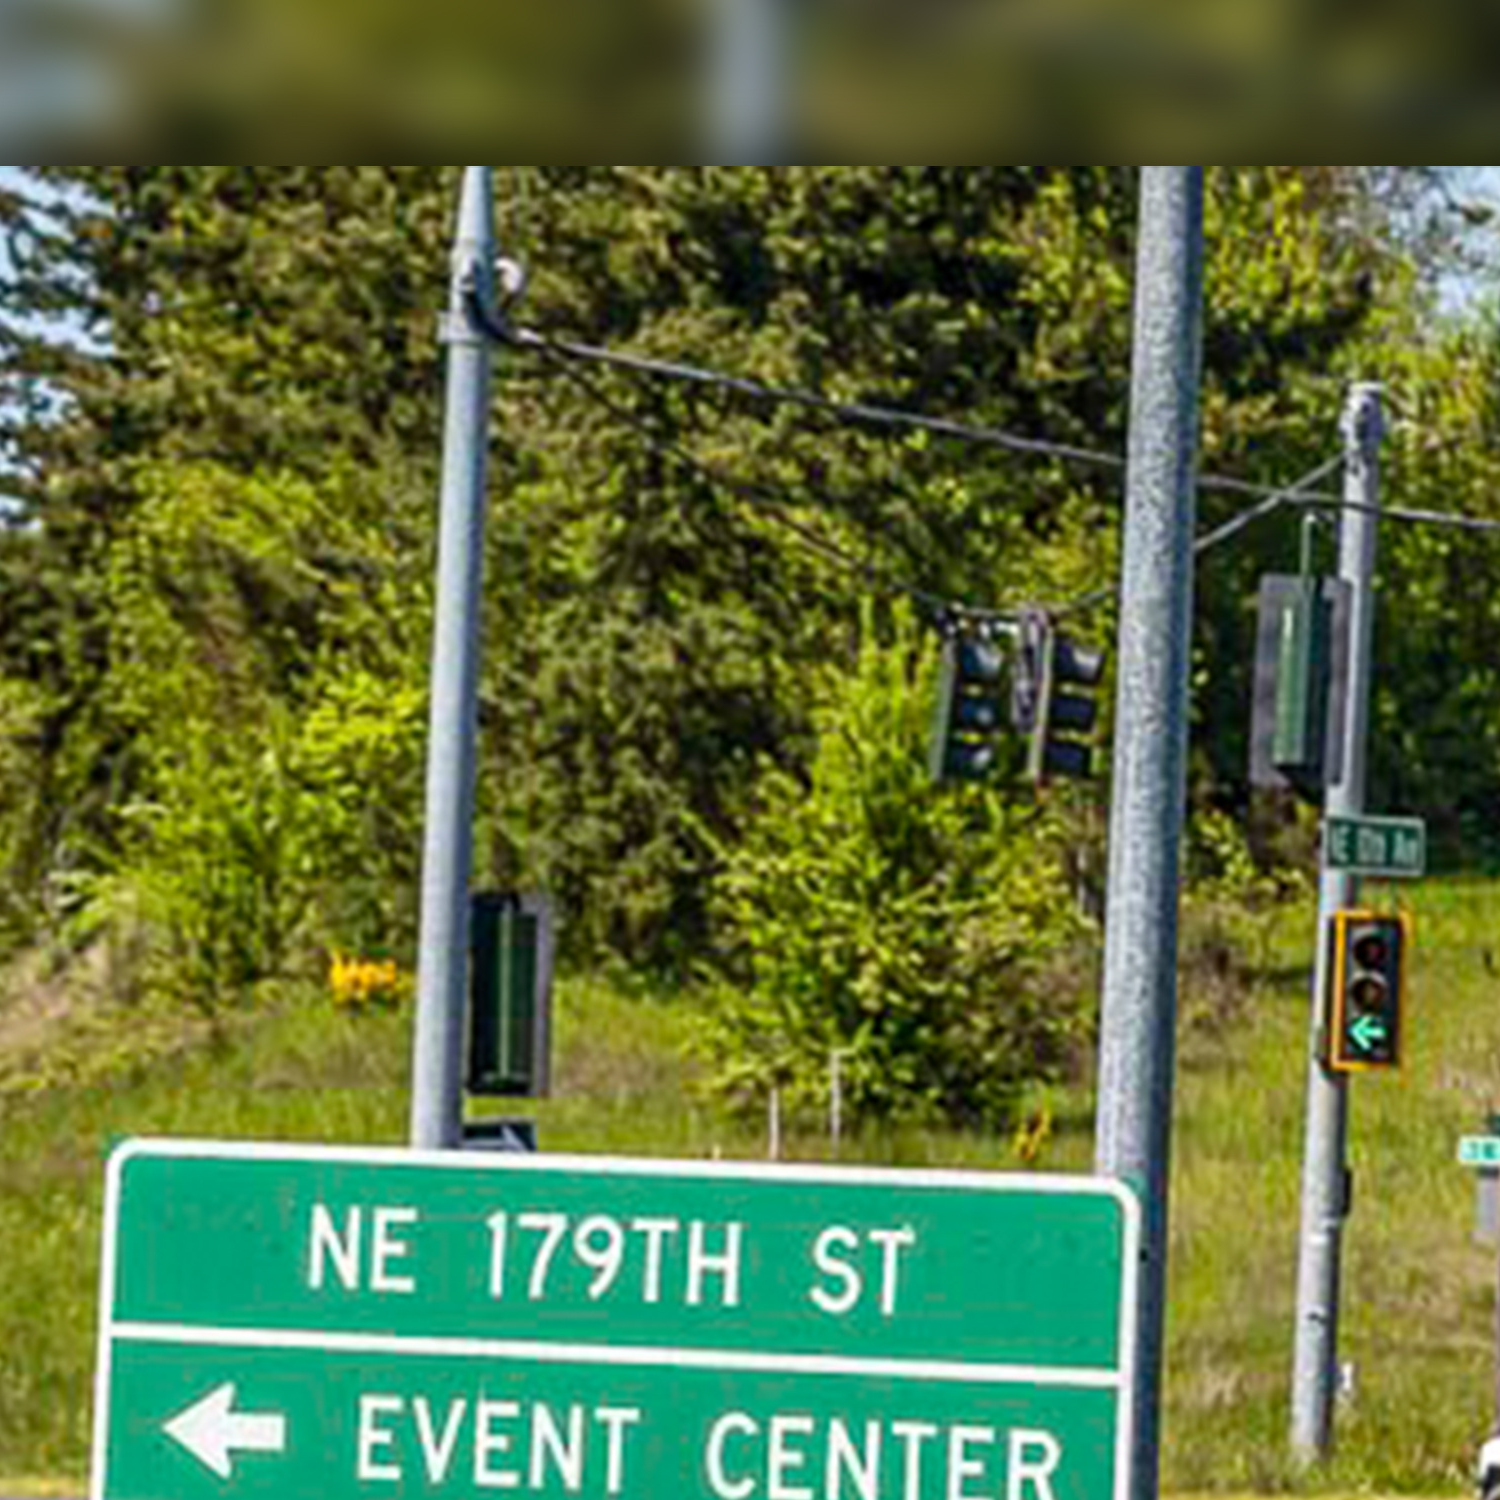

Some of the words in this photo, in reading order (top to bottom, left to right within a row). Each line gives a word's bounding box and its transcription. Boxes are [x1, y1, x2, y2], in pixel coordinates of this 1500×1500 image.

[308, 1203, 418, 1293] NE
[486, 1211, 742, 1305] 179TH
[808, 1226, 917, 1316] ST
[356, 1394, 640, 1494] EVENT
